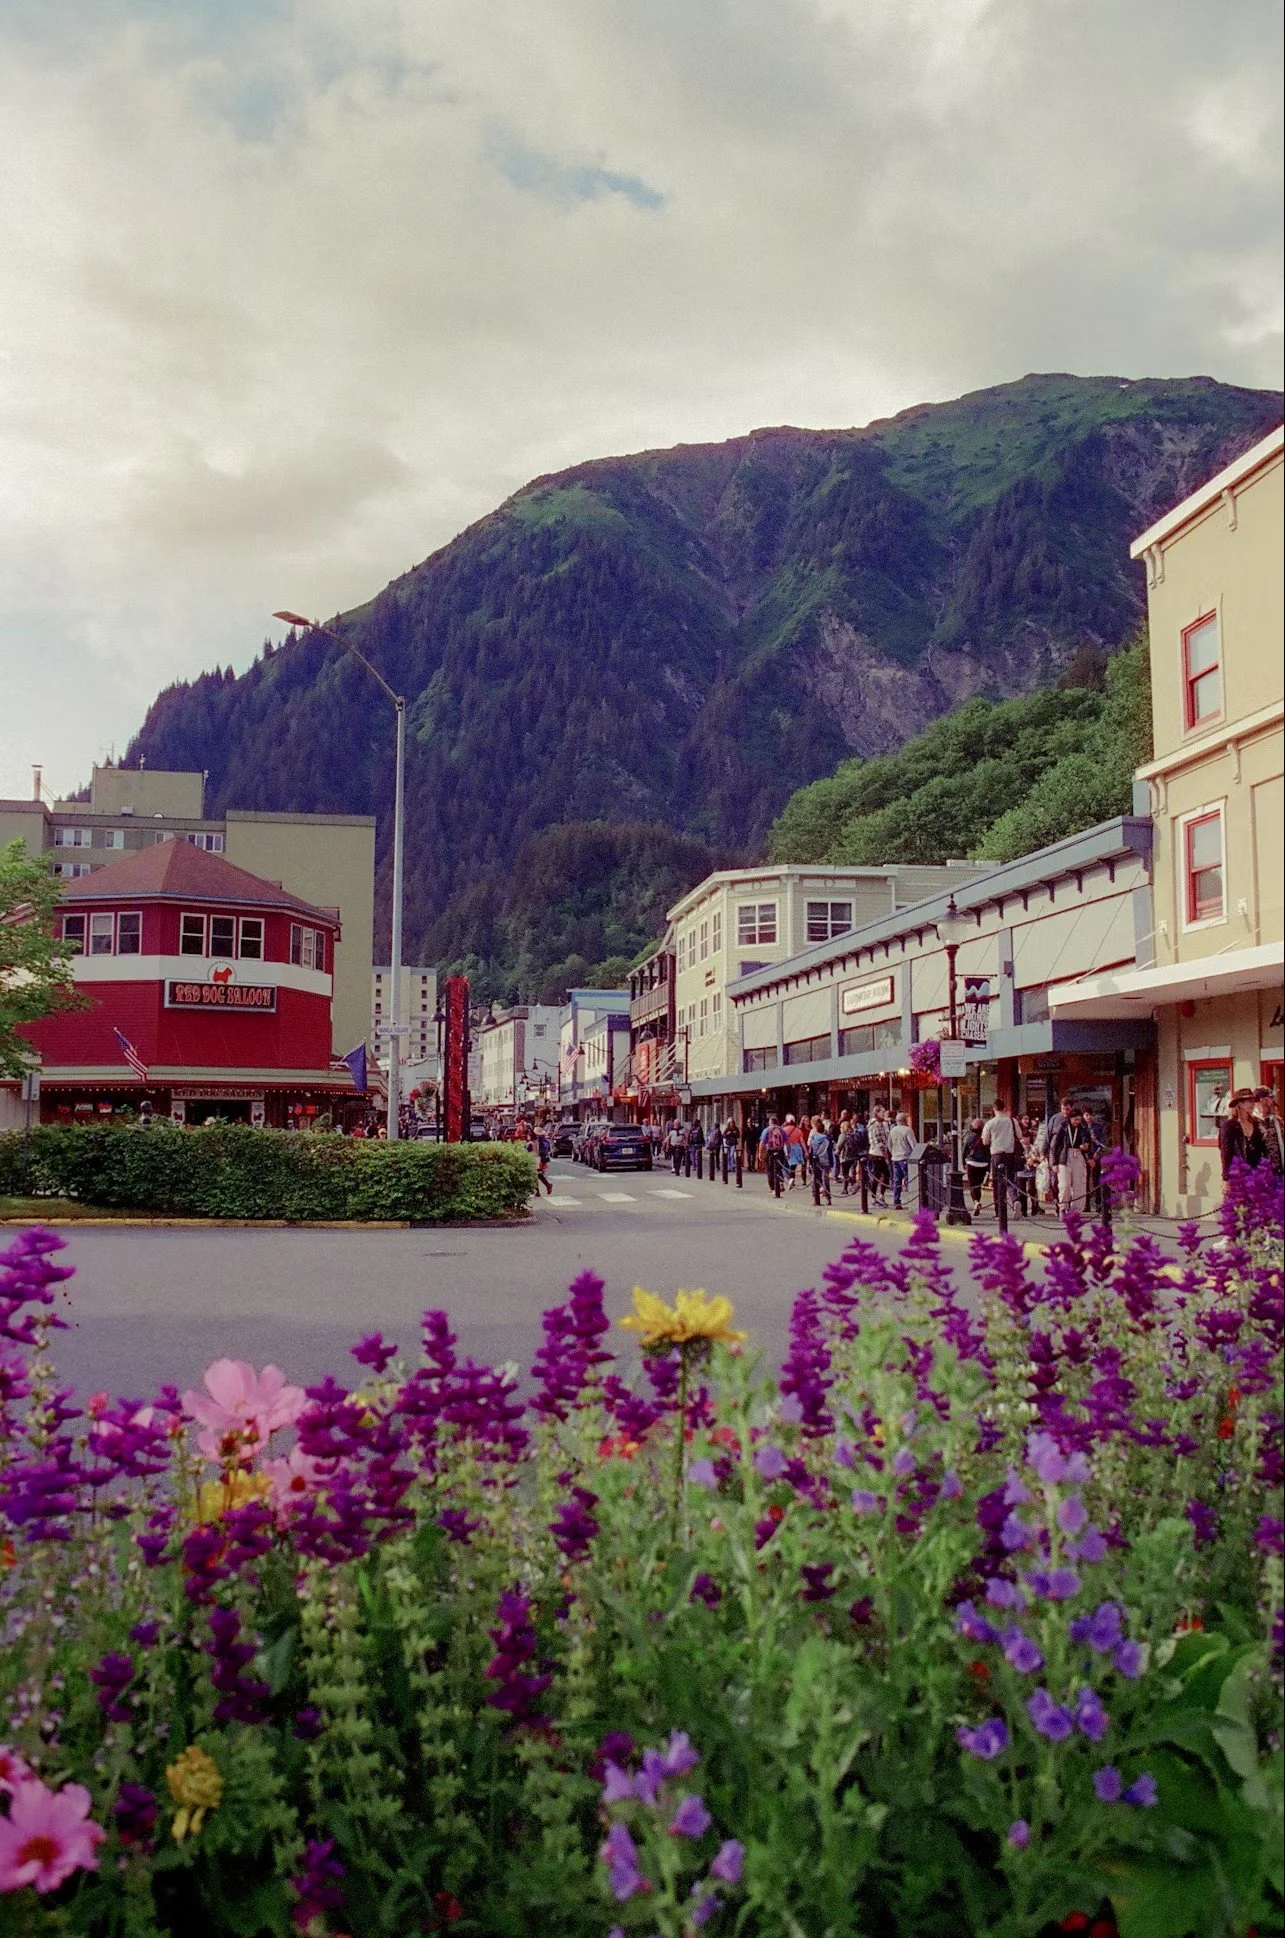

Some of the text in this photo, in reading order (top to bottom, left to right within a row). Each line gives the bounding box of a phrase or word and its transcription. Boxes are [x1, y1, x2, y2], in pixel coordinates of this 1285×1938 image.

[175, 984, 271, 1006] RED DOG SALOON
[174, 1088, 262, 1098] RED DOG SALOON
